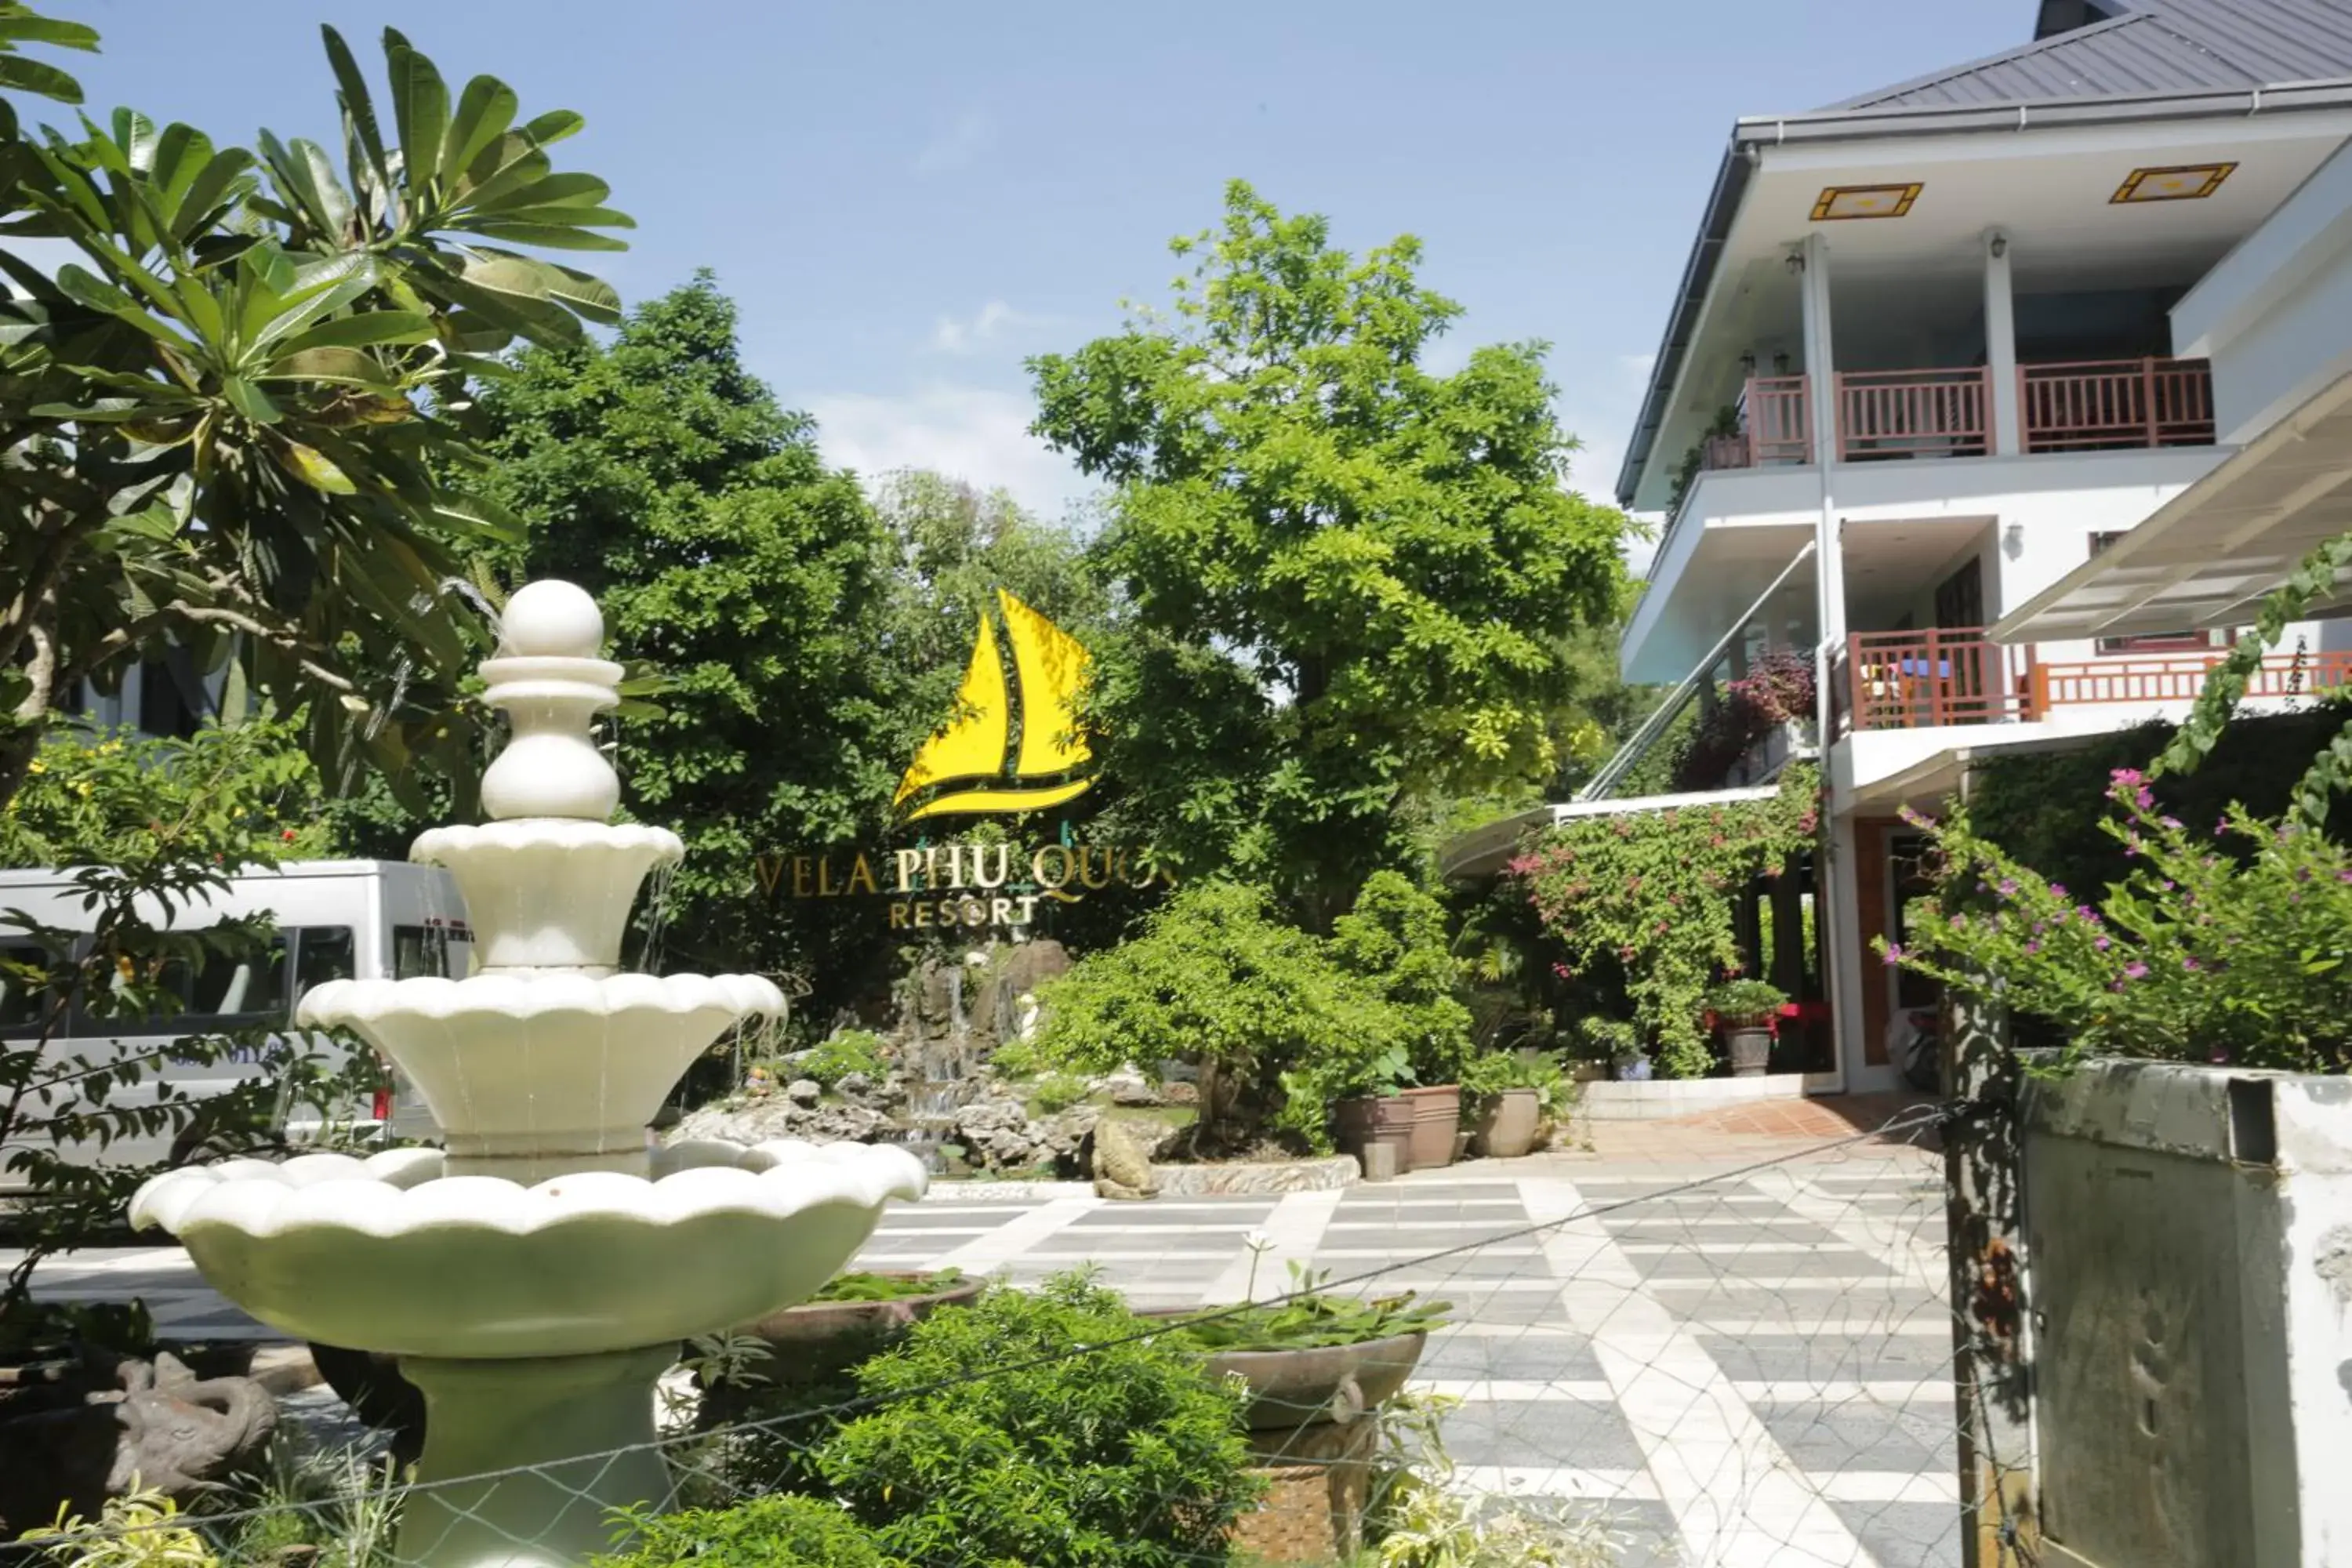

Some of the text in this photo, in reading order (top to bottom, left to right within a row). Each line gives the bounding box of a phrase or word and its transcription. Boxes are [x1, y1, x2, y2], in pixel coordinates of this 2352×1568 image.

[754, 852, 879, 898] VELA
[895, 844, 1010, 894] PHU
[889, 896, 1039, 929] RESORT
